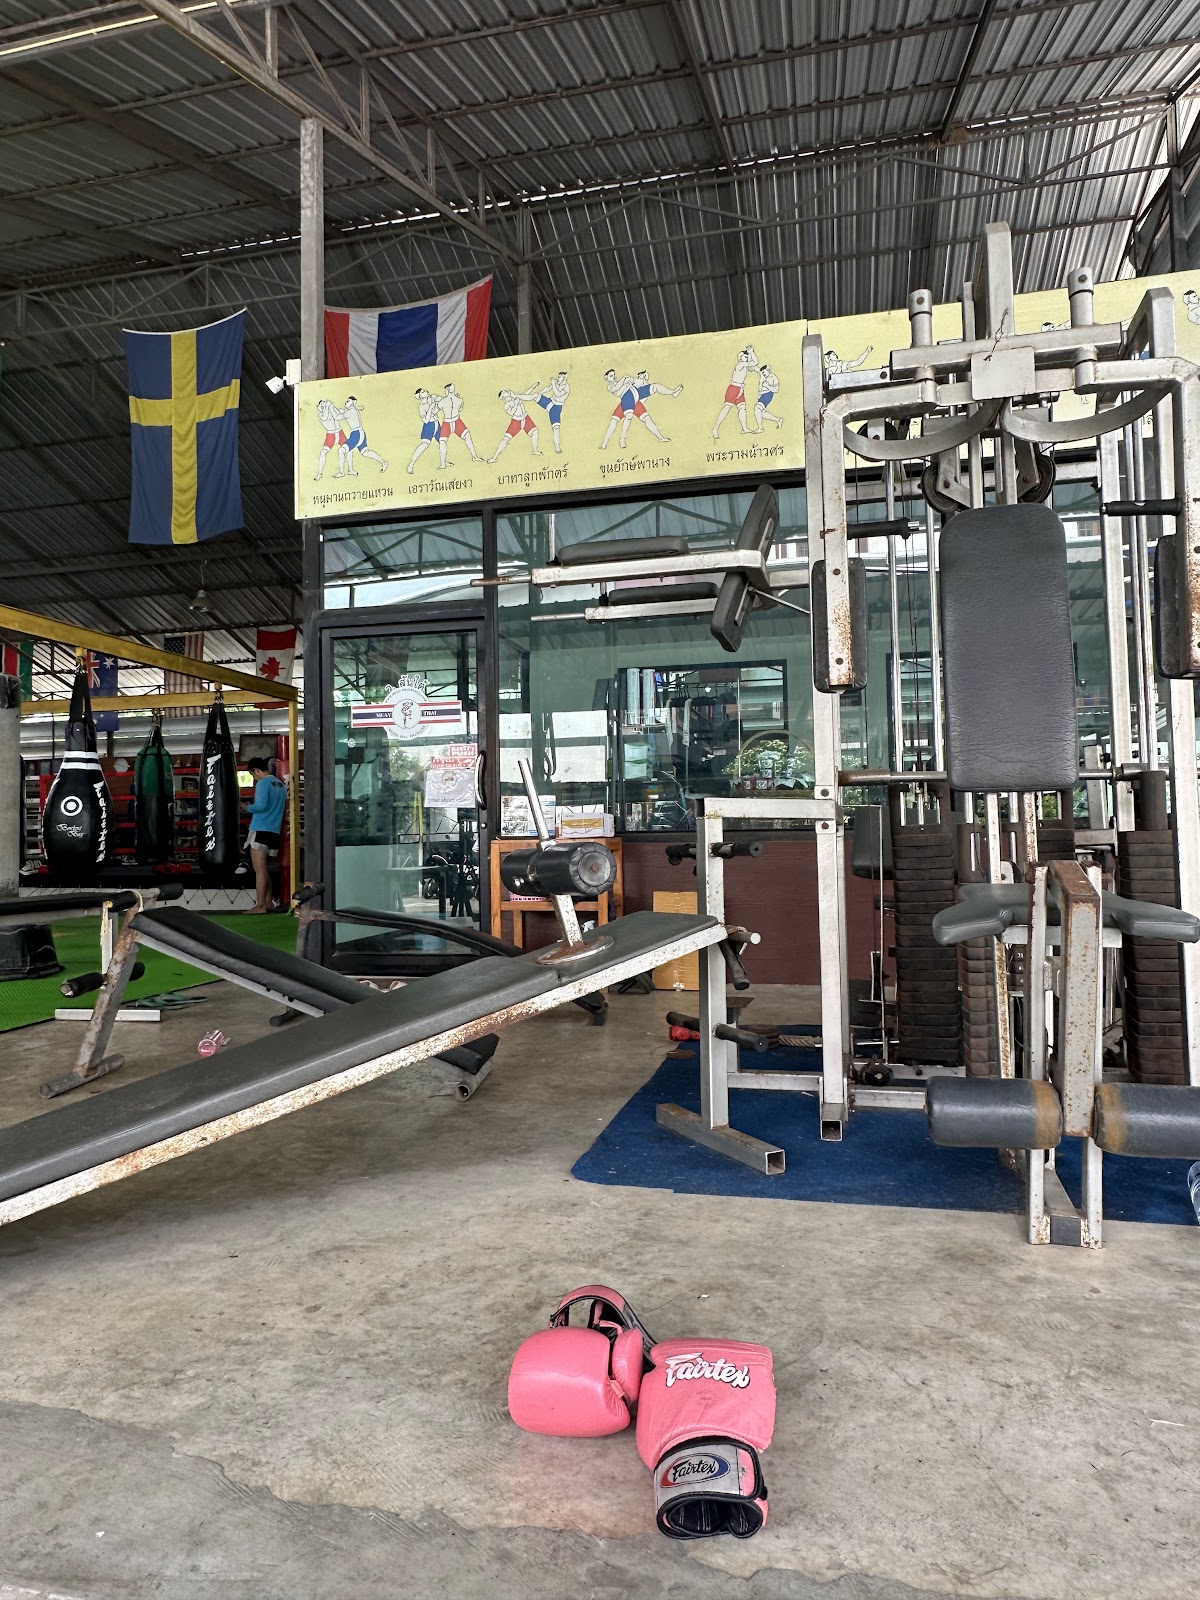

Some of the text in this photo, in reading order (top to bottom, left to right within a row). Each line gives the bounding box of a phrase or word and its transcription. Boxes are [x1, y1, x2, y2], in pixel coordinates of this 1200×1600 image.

[706, 443, 784, 462] พระรามน้าวศร
[205, 753, 222, 851] Fairtex
[93, 780, 108, 862] Fairtex
[665, 1352, 751, 1389] Fairtex
[672, 1459, 717, 1482] Fairtex
